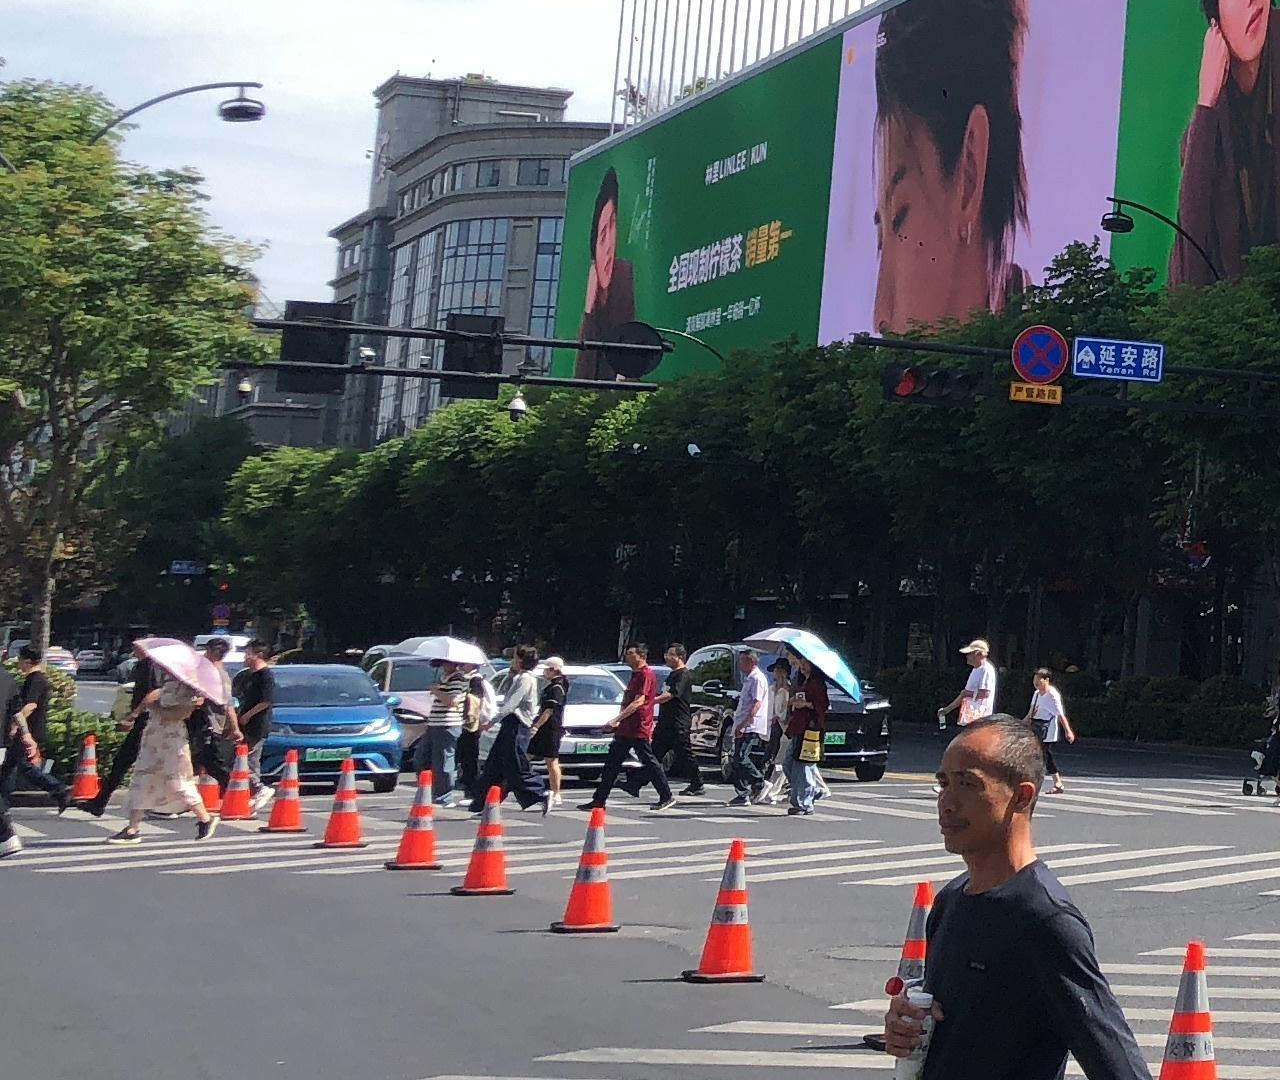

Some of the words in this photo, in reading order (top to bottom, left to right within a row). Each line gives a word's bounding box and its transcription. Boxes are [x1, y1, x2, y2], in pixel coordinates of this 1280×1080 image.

[1099, 345, 1158, 369] 延安路
[1142, 368, 1157, 376] Rd
